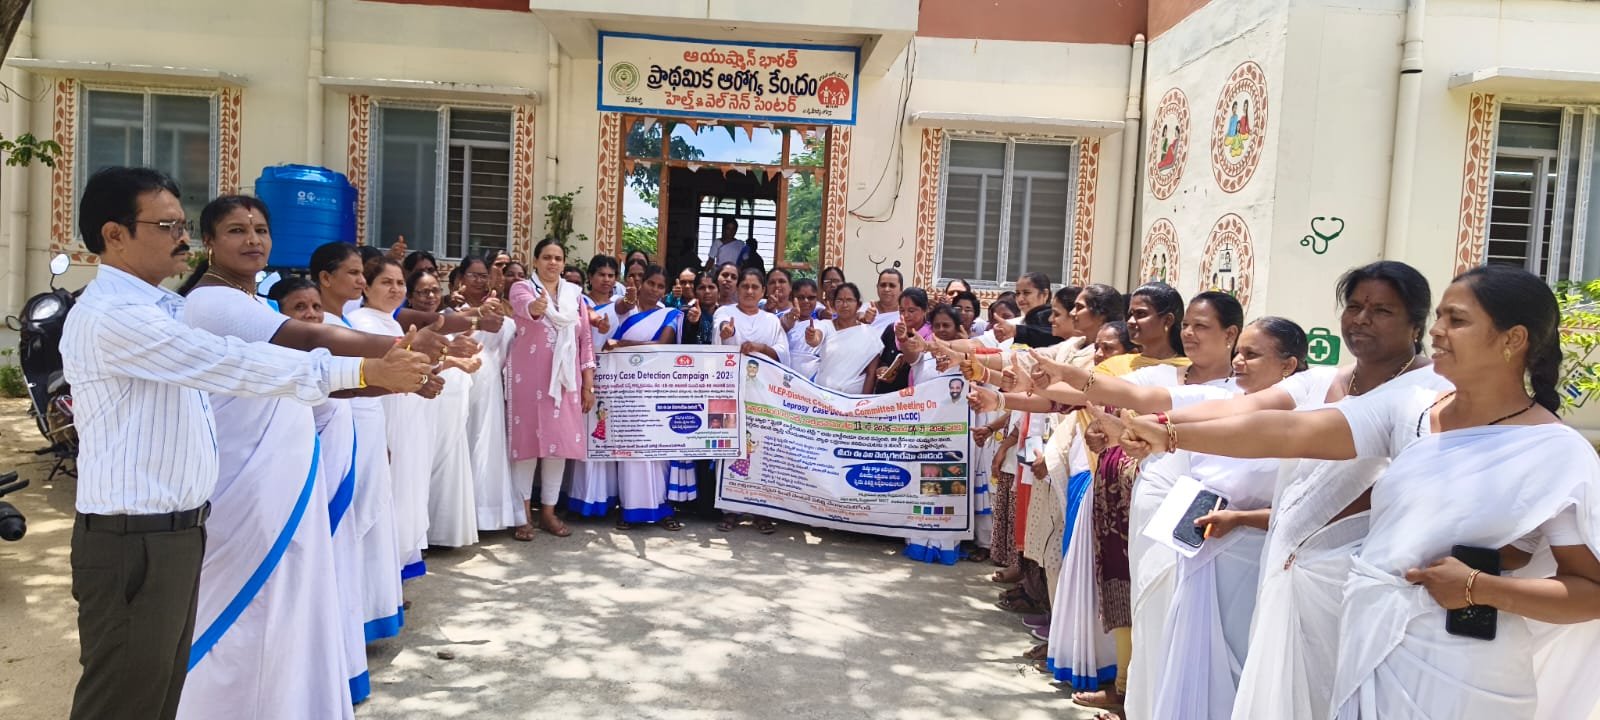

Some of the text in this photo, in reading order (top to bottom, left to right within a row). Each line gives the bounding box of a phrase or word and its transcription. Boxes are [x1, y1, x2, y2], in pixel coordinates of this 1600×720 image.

[759, 49, 798, 69] భారత్
[647, 64, 817, 97] ప్రాథమిక ఆరోగ్య కేంద్రం
[754, 95, 799, 113] సెంటర్
[593, 373, 617, 382] eprosy
[619, 371, 635, 380] Case
[637, 370, 670, 380] Detection
[672, 370, 709, 382] Campaign
[783, 400, 809, 414] Leprosy
[812, 406, 829, 415] Case
[898, 411, 920, 422] (LCDC)
[854, 404, 895, 416] Committee
[896, 400, 925, 411] Meeting
[926, 400, 937, 409] On
